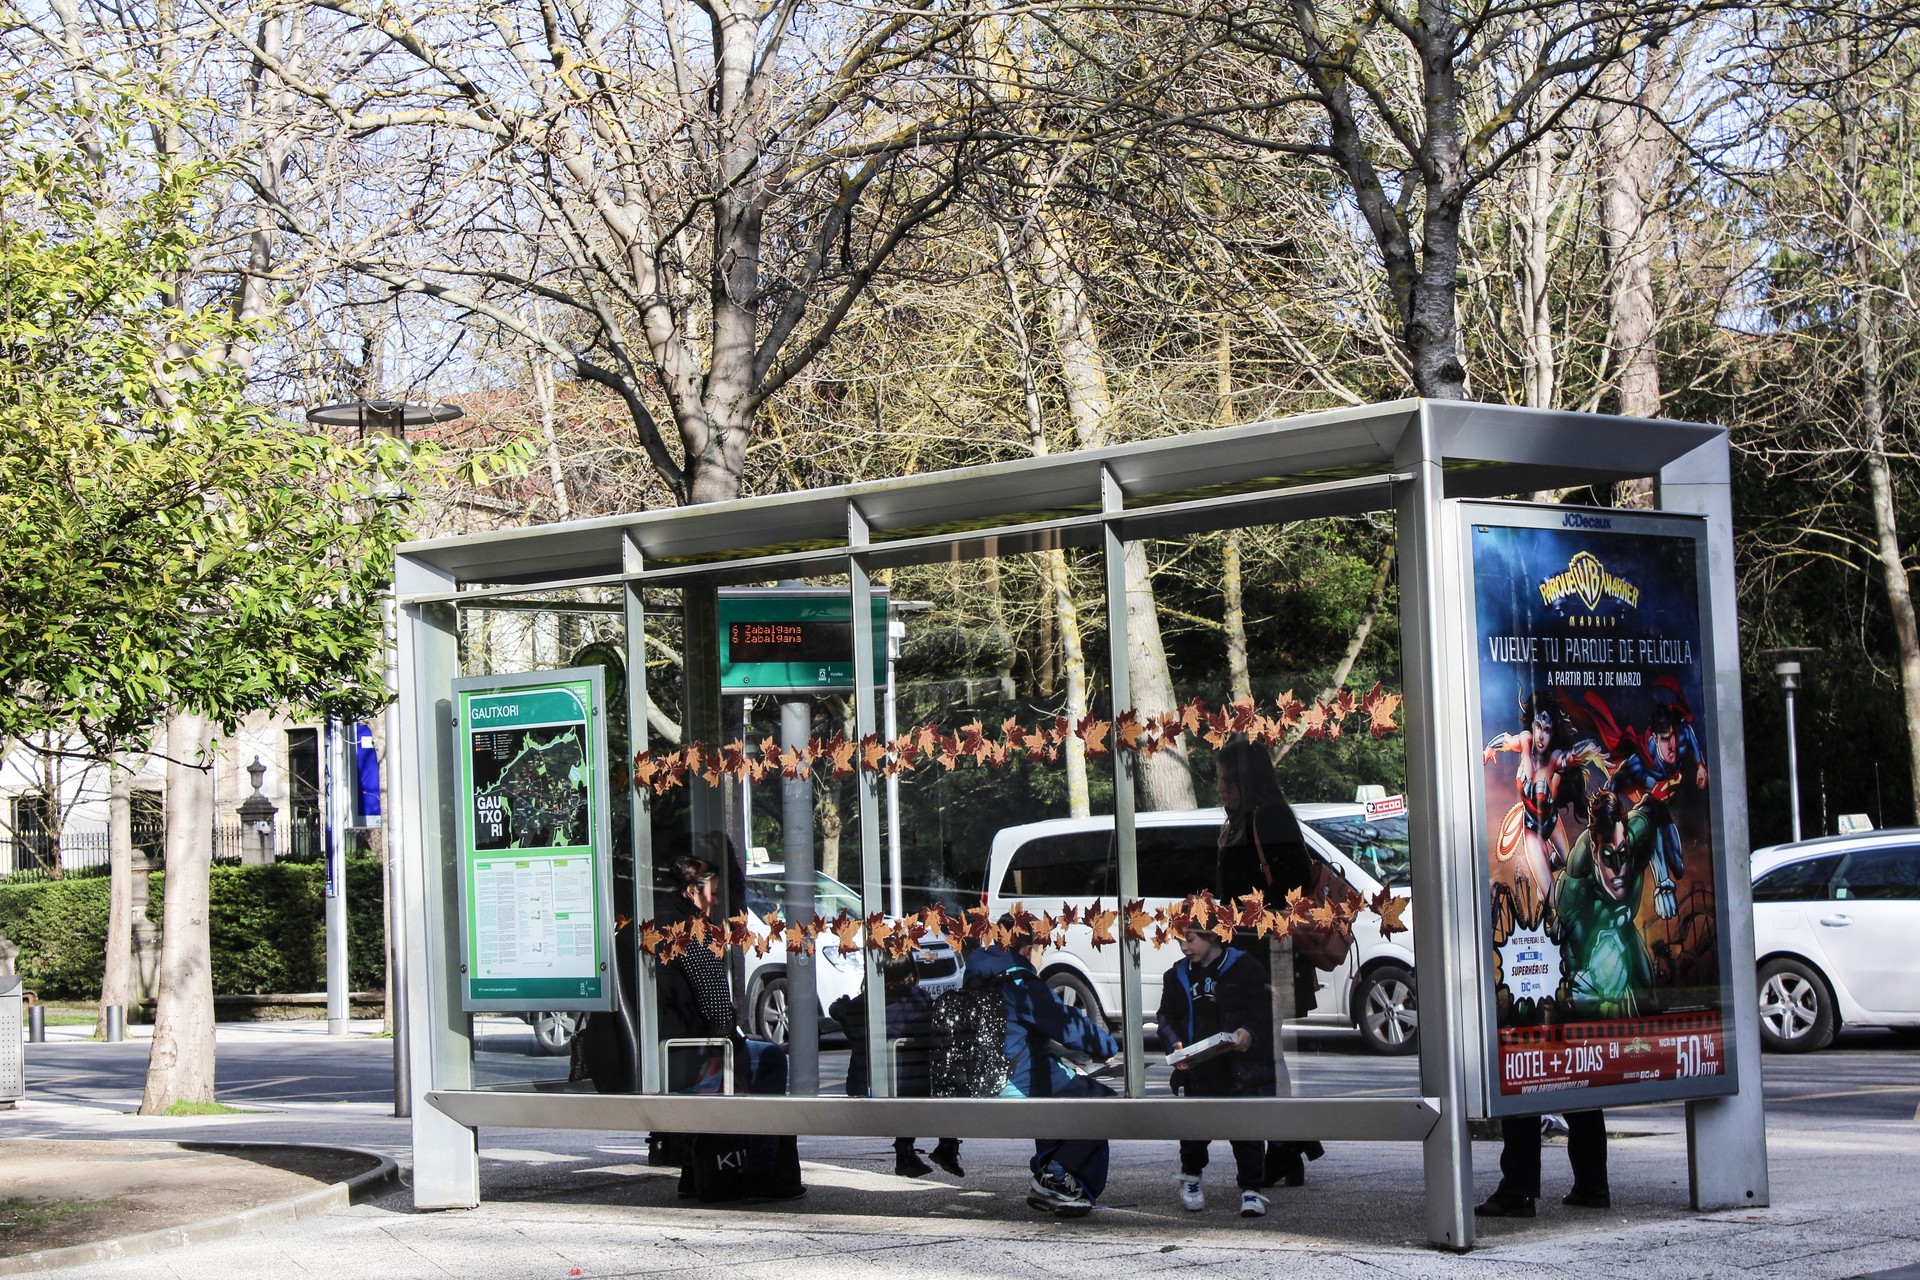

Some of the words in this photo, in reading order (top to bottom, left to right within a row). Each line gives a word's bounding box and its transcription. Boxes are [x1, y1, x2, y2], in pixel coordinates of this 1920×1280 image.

[1562, 512, 1611, 530] JCDecaux
[1539, 572, 1577, 606] PARQUE
[1603, 573, 1640, 609] WARNER
[1568, 615, 1616, 627] MADRID
[732, 626, 739, 635] 6
[744, 625, 802, 635] Zabalgana
[732, 635, 739, 644] 6
[744, 635, 802, 643] Zabalgana
[1489, 636, 1538, 663] VUELVE
[1542, 637, 1559, 663] TU
[1565, 637, 1614, 663] PARQUE
[1619, 638, 1635, 664] DE
[1639, 635, 1692, 665] PELÍCULA
[1547, 671, 1553, 686] A
[1555, 671, 1581, 686] PARTIR
[1583, 671, 1596, 686] DEL
[1598, 671, 1603, 686] 3
[1605, 672, 1614, 686] DE
[1615, 672, 1642, 686] MARZO
[471, 704, 519, 720] GAUTXORI
[477, 796, 502, 810] GAU
[478, 811, 502, 824] TXO
[491, 824, 503, 837] RI
[1511, 963, 1549, 976] SUPERHÉROES
[1521, 982, 1531, 992] DC
[1505, 1050, 1547, 1080] HOTEL
[1549, 1053, 1562, 1073] +
[1565, 1048, 1573, 1074] 2
[1575, 1040, 1603, 1073] DÍAS
[1609, 1041, 1620, 1059] EN
